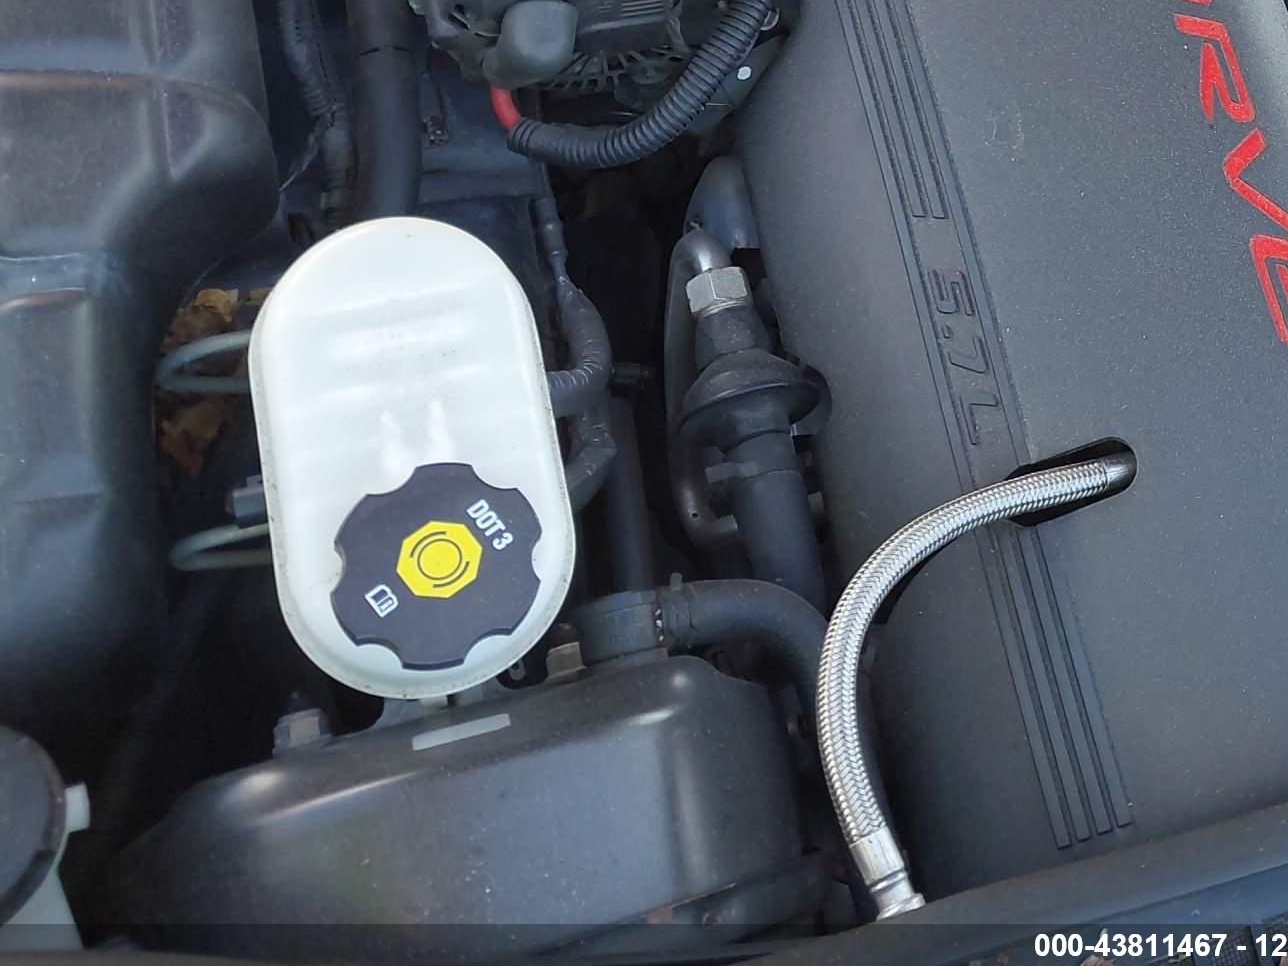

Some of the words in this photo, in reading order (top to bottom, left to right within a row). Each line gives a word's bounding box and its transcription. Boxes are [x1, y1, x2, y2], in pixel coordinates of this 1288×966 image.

[928, 268, 1000, 446] 5.7L
[466, 499, 506, 537] DOT
[492, 532, 514, 550] 3
